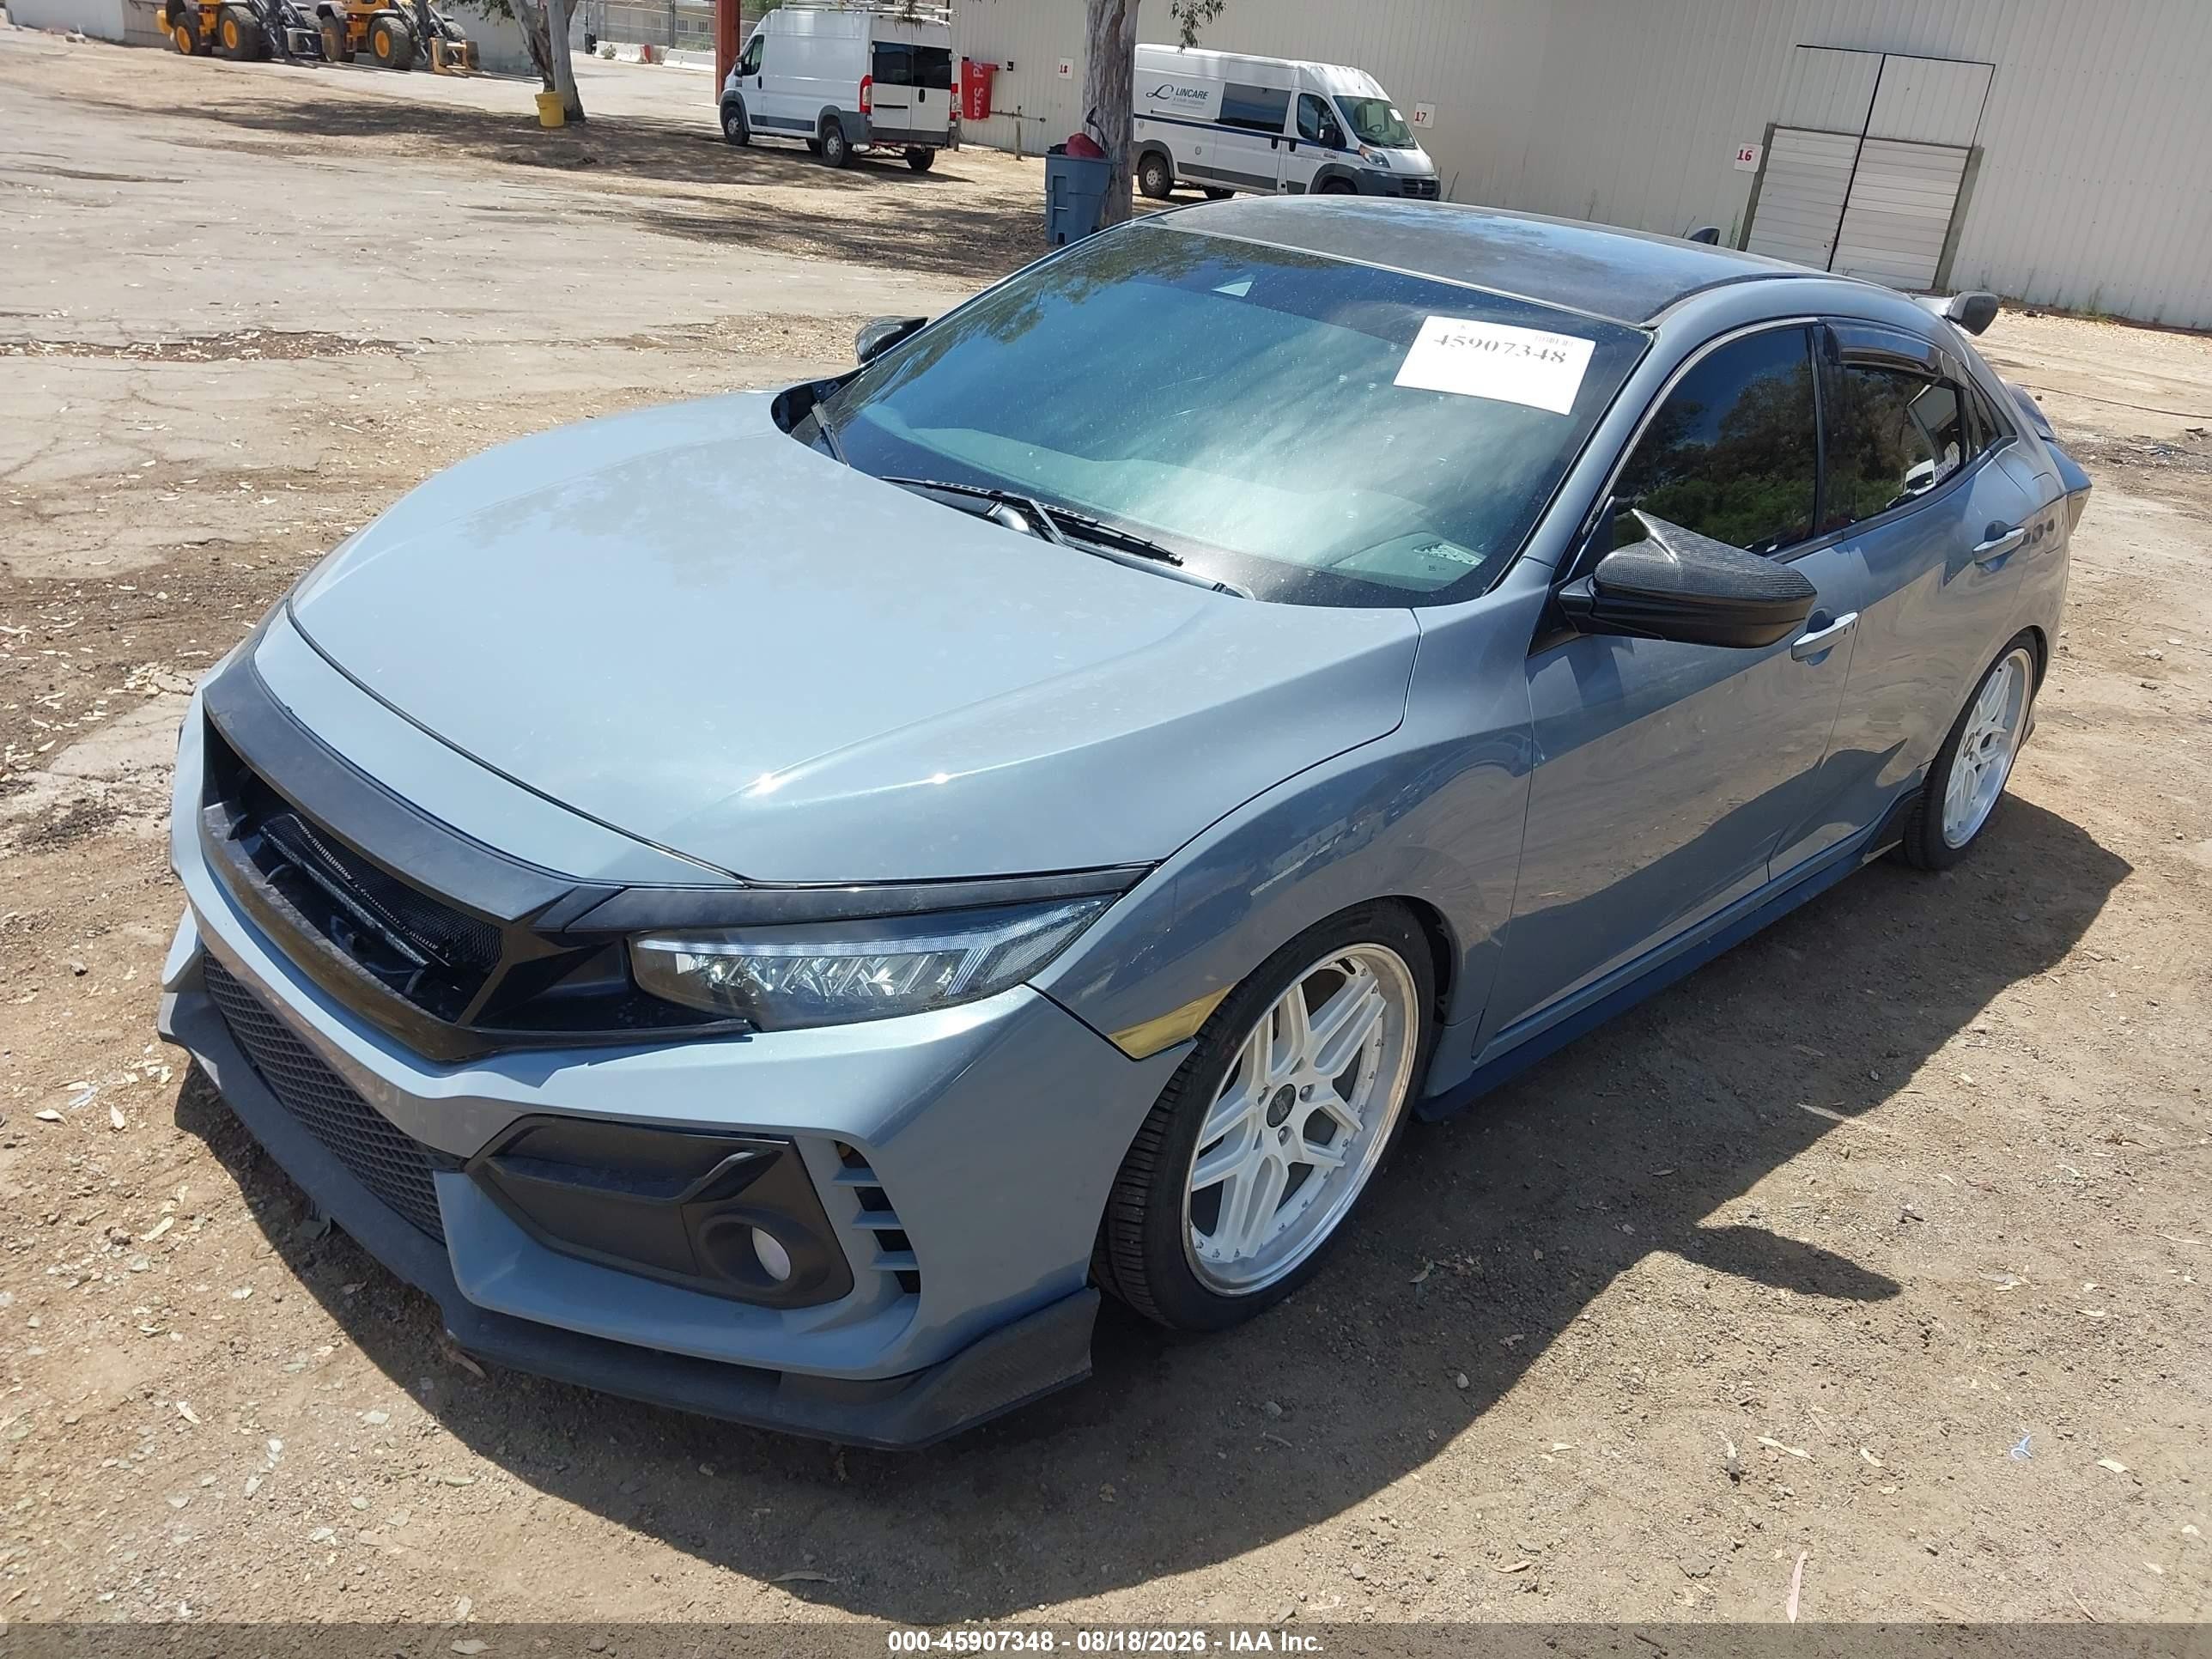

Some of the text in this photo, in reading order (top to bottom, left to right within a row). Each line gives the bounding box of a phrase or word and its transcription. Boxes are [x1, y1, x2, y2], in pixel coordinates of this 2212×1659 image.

[1175, 87, 1209, 100] LINCARE
[1414, 111, 1427, 123] 17
[1736, 149, 1753, 161] 16
[1433, 334, 1567, 363] 45907348
